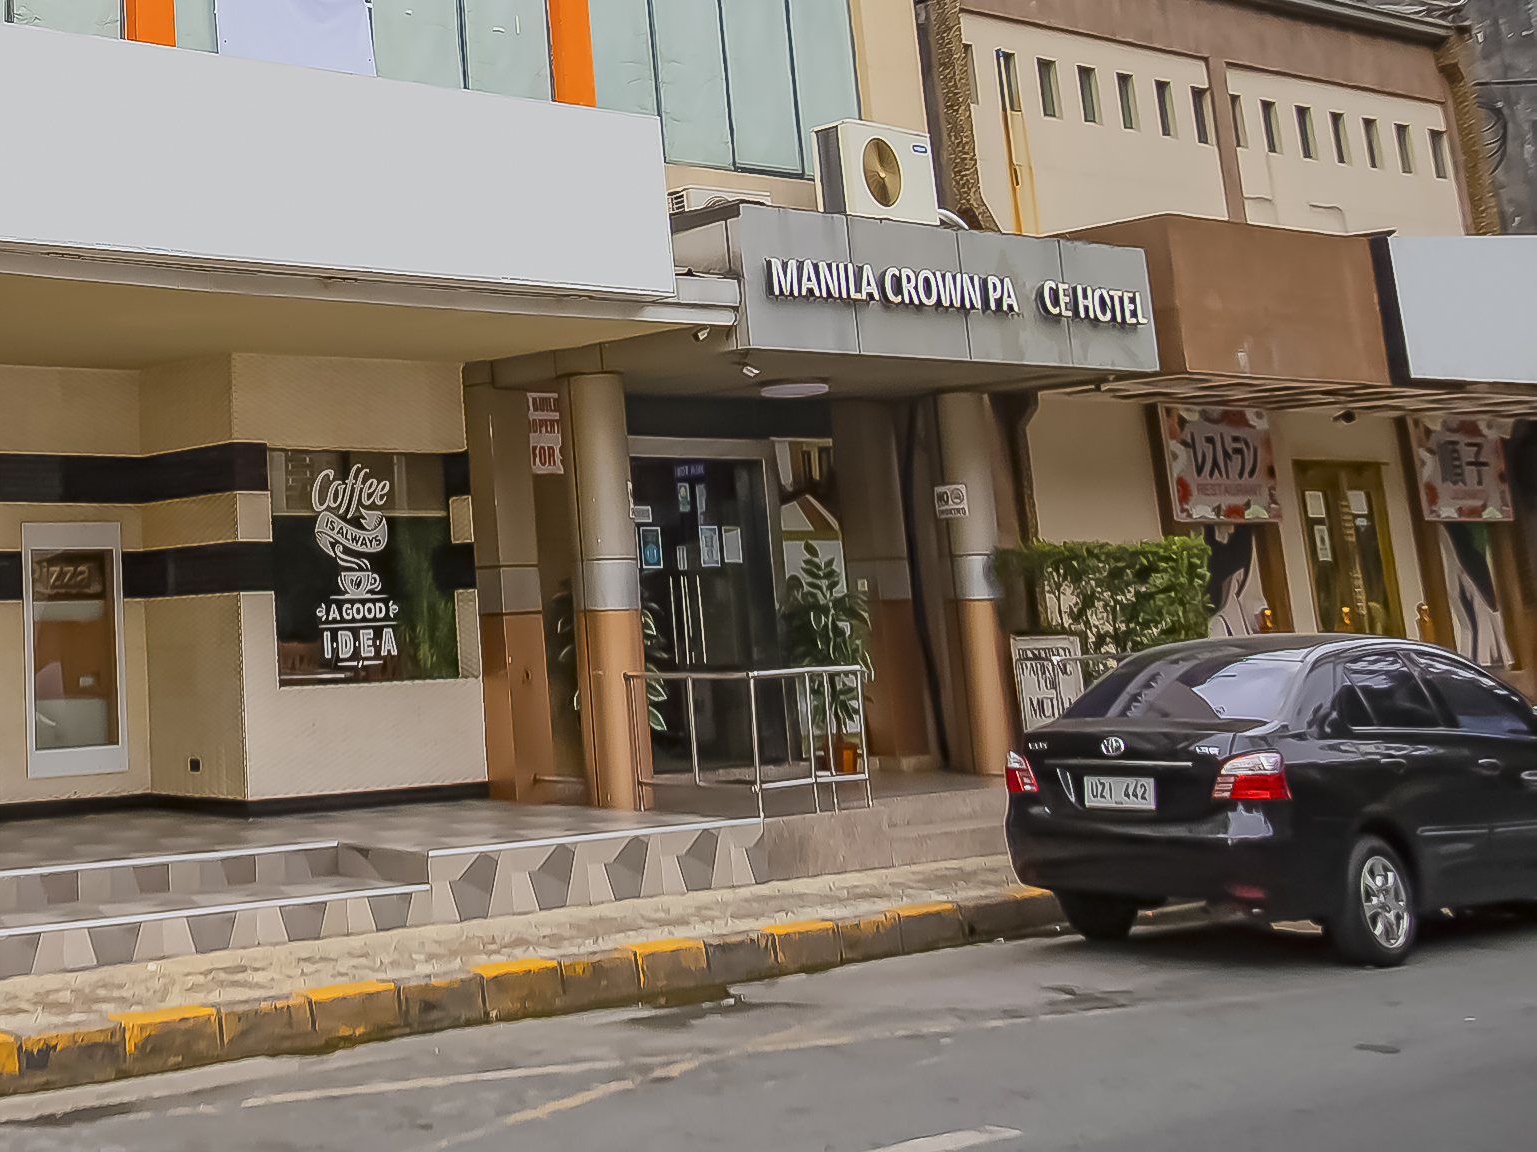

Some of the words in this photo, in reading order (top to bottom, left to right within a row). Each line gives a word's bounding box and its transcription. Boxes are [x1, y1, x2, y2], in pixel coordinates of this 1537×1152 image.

[766, 257, 879, 302] MANILA
[882, 266, 982, 311] CROWN
[1076, 284, 1149, 325] HOTEL
[531, 445, 558, 467] FOR
[1189, 431, 1259, 481] レストラン
[311, 463, 391, 520] Coffee
[324, 516, 336, 533] IS
[335, 524, 383, 550] ALWAYS
[328, 603, 341, 622] A
[342, 602, 387, 620] GOOD
[1123, 779, 1148, 802] 442
